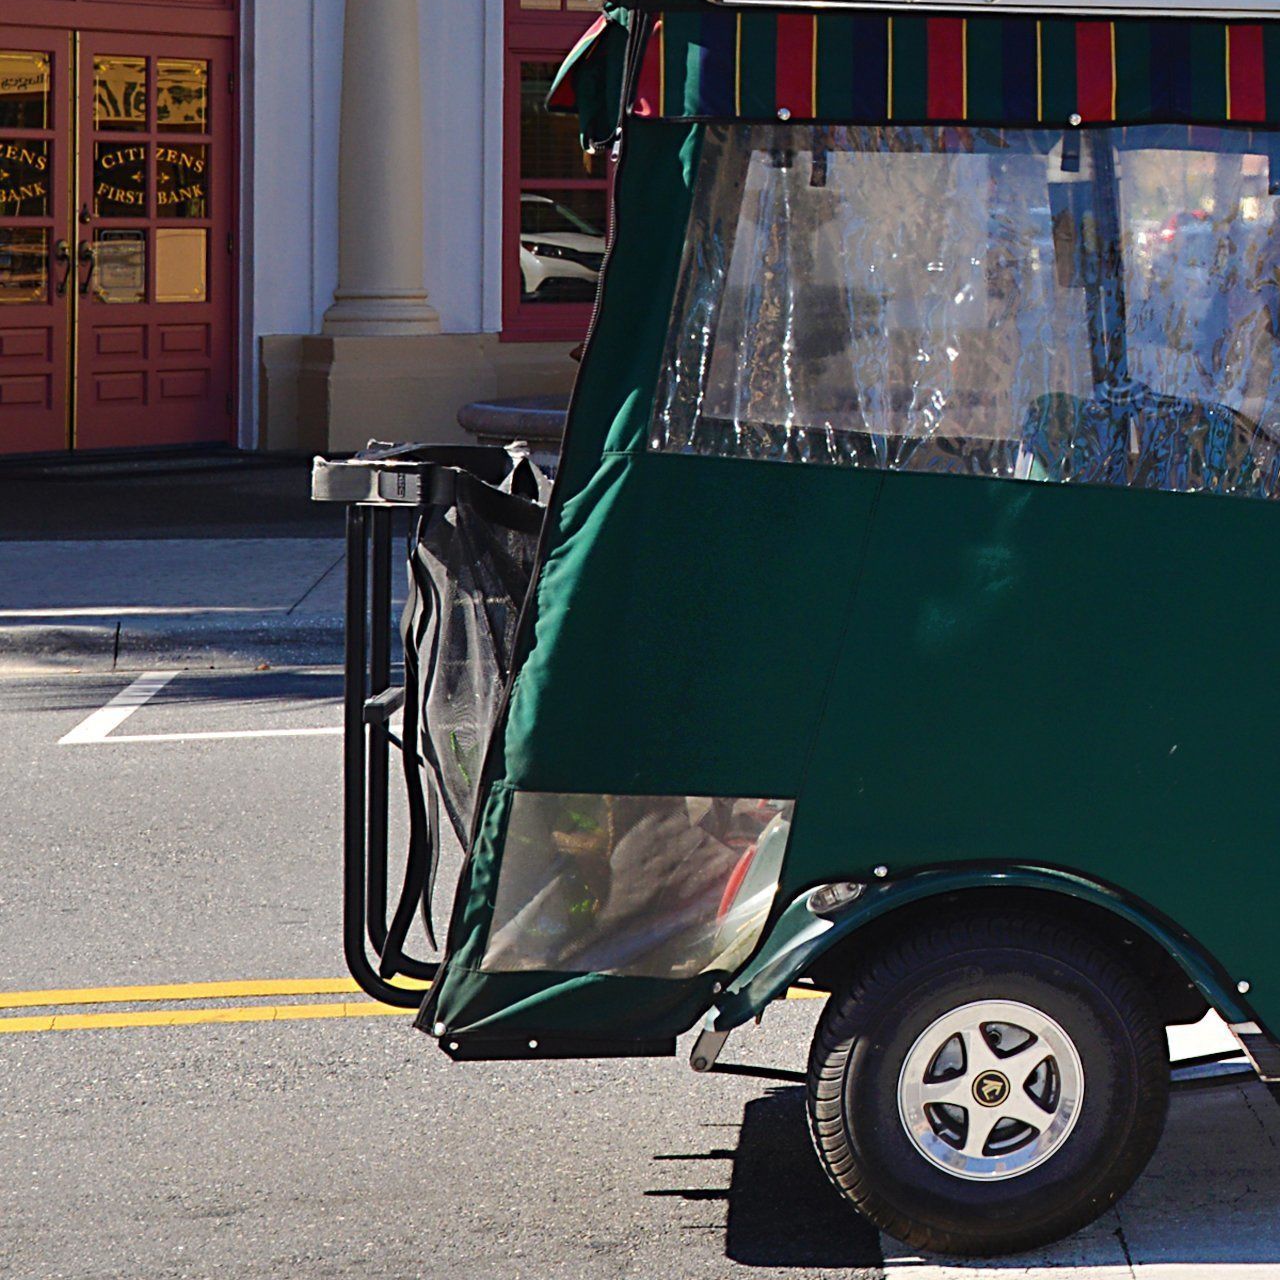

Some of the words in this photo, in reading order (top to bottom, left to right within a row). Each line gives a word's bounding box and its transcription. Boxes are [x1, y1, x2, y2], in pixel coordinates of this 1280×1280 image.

[101, 147, 205, 173] CITIZENS
[97, 182, 145, 205] FIRST
[157, 184, 204, 205] BANK
